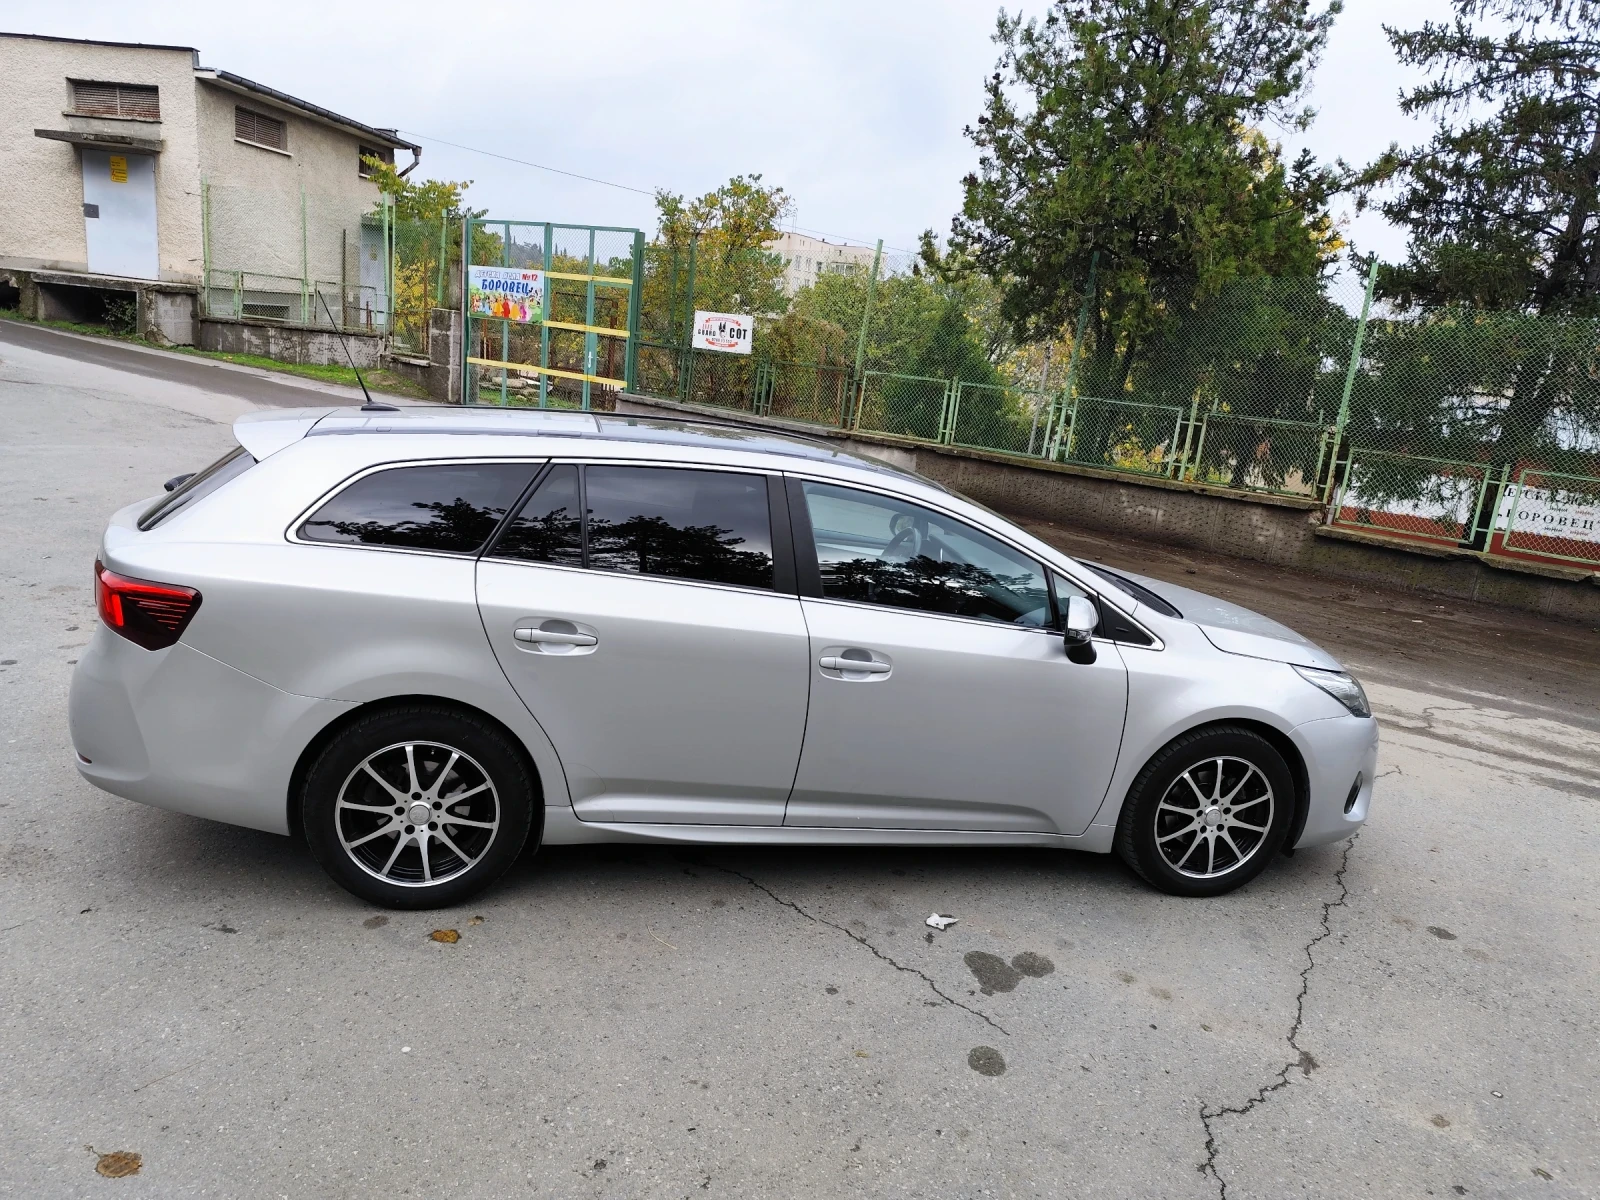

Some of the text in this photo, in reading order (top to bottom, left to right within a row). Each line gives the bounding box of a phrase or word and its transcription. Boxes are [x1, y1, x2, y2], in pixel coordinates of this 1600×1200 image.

[475, 270, 500, 279] ДЕТСКА
[482, 279, 529, 296] БОРОВЕЦ
[698, 329, 716, 337] GUARD
[730, 327, 748, 340] СОТ
